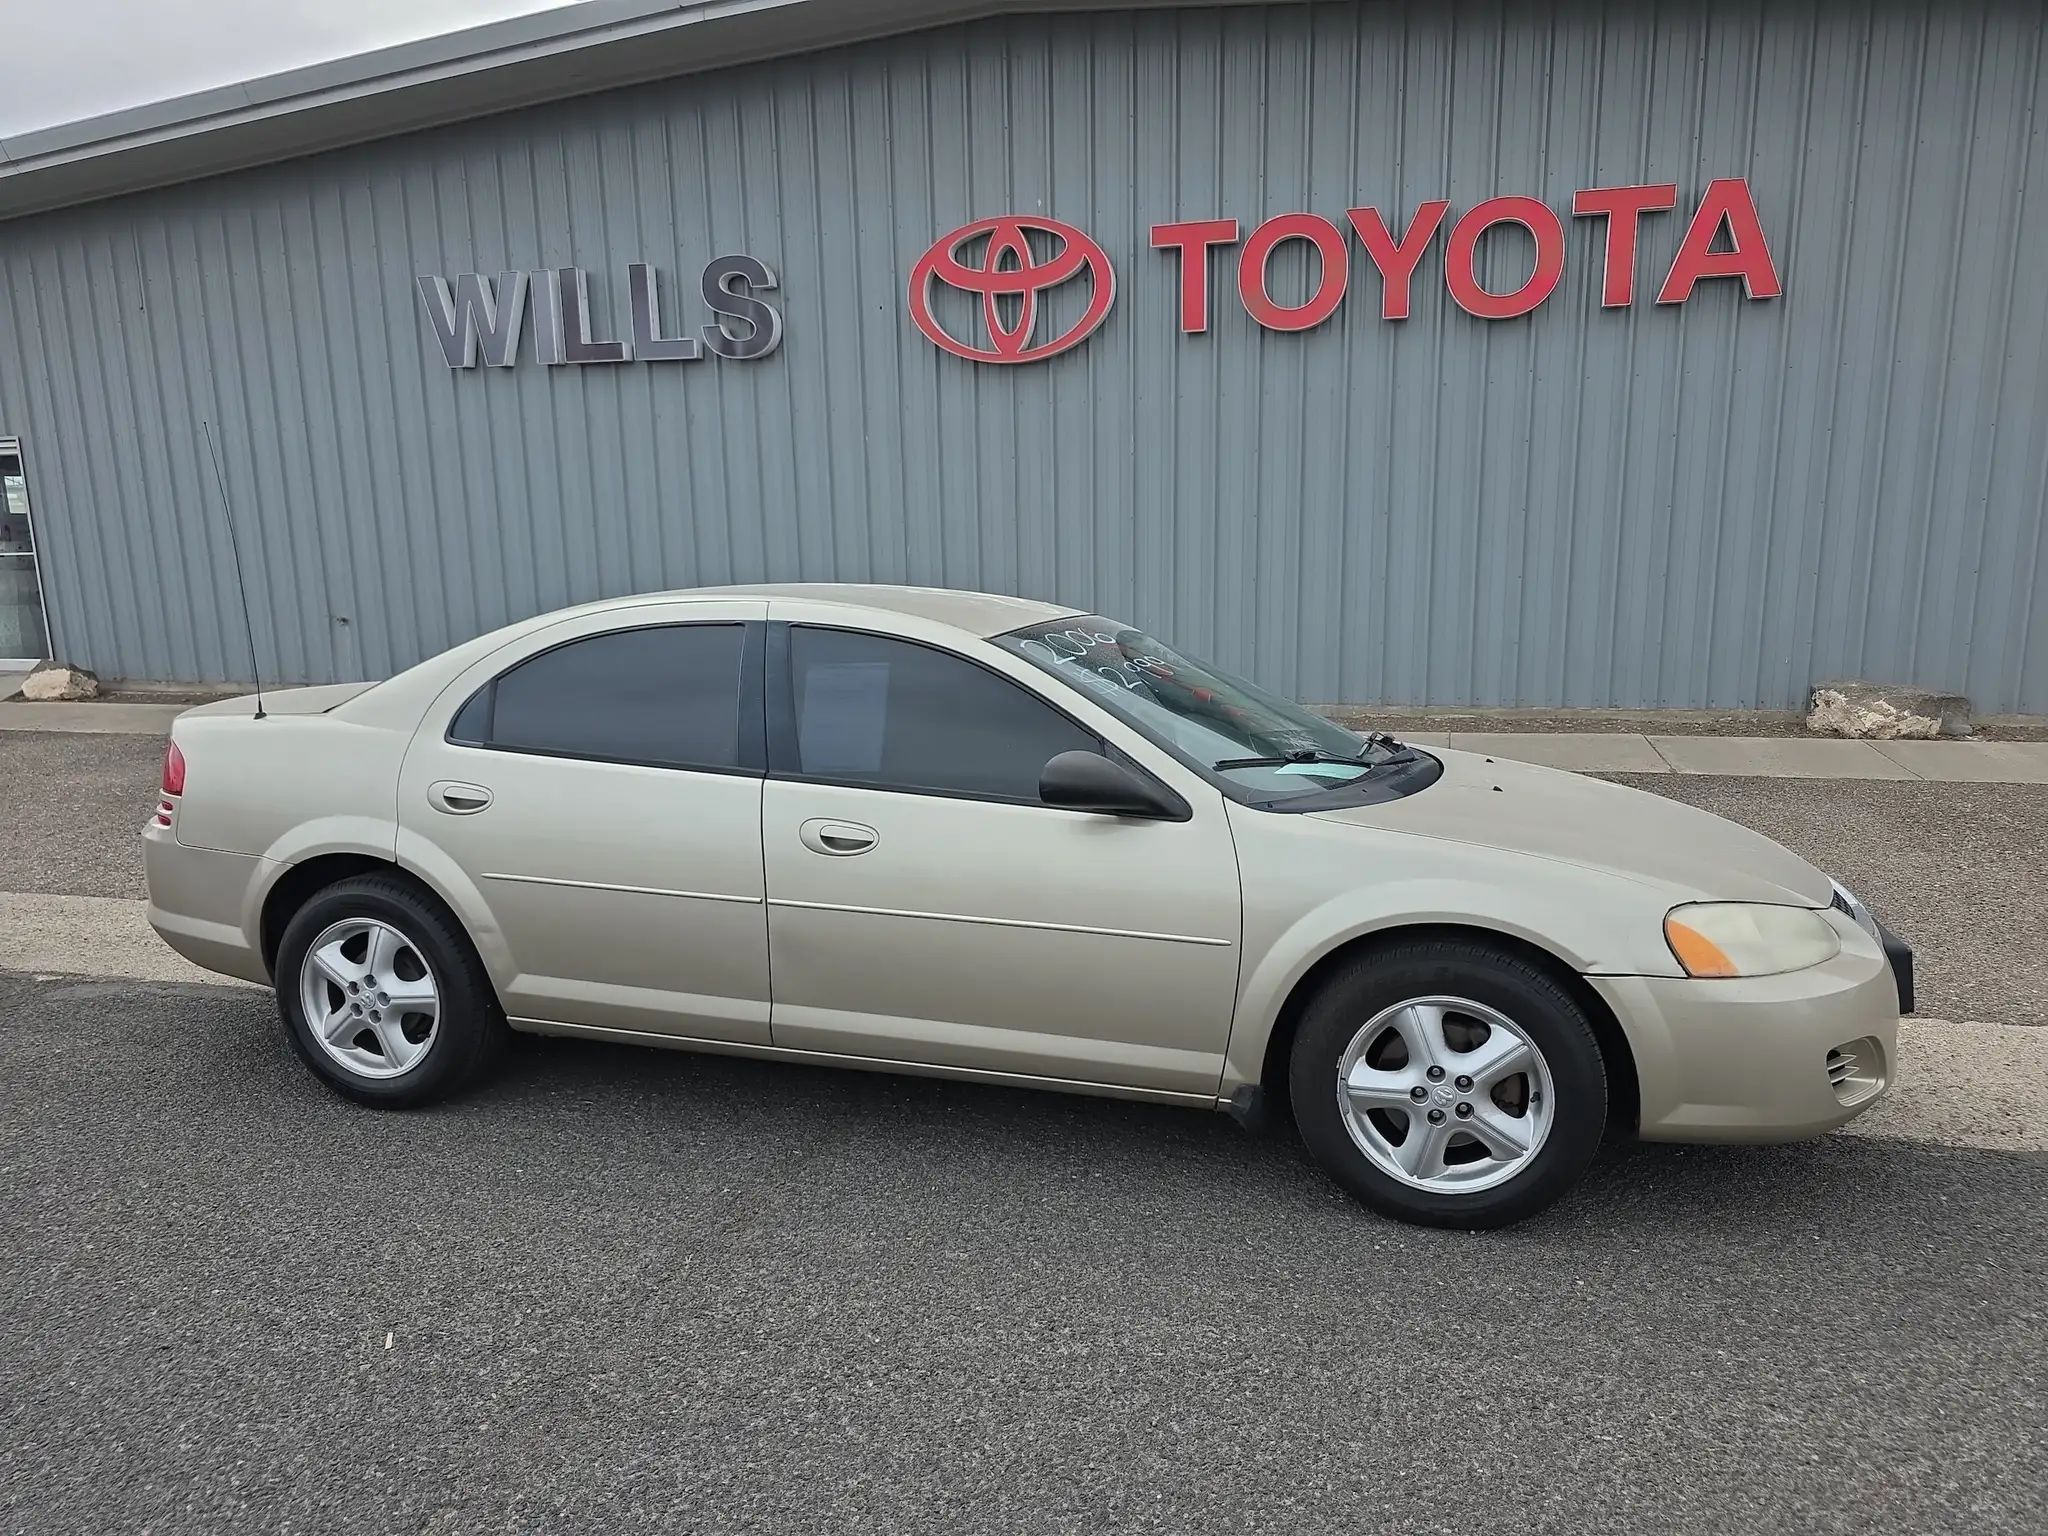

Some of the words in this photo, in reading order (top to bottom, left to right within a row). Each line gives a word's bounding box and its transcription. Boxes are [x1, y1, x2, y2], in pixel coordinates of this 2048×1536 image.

[416, 254, 783, 369] WILLS
[1150, 178, 1783, 333] TOYOTA
[1020, 627, 1116, 665] 2006
